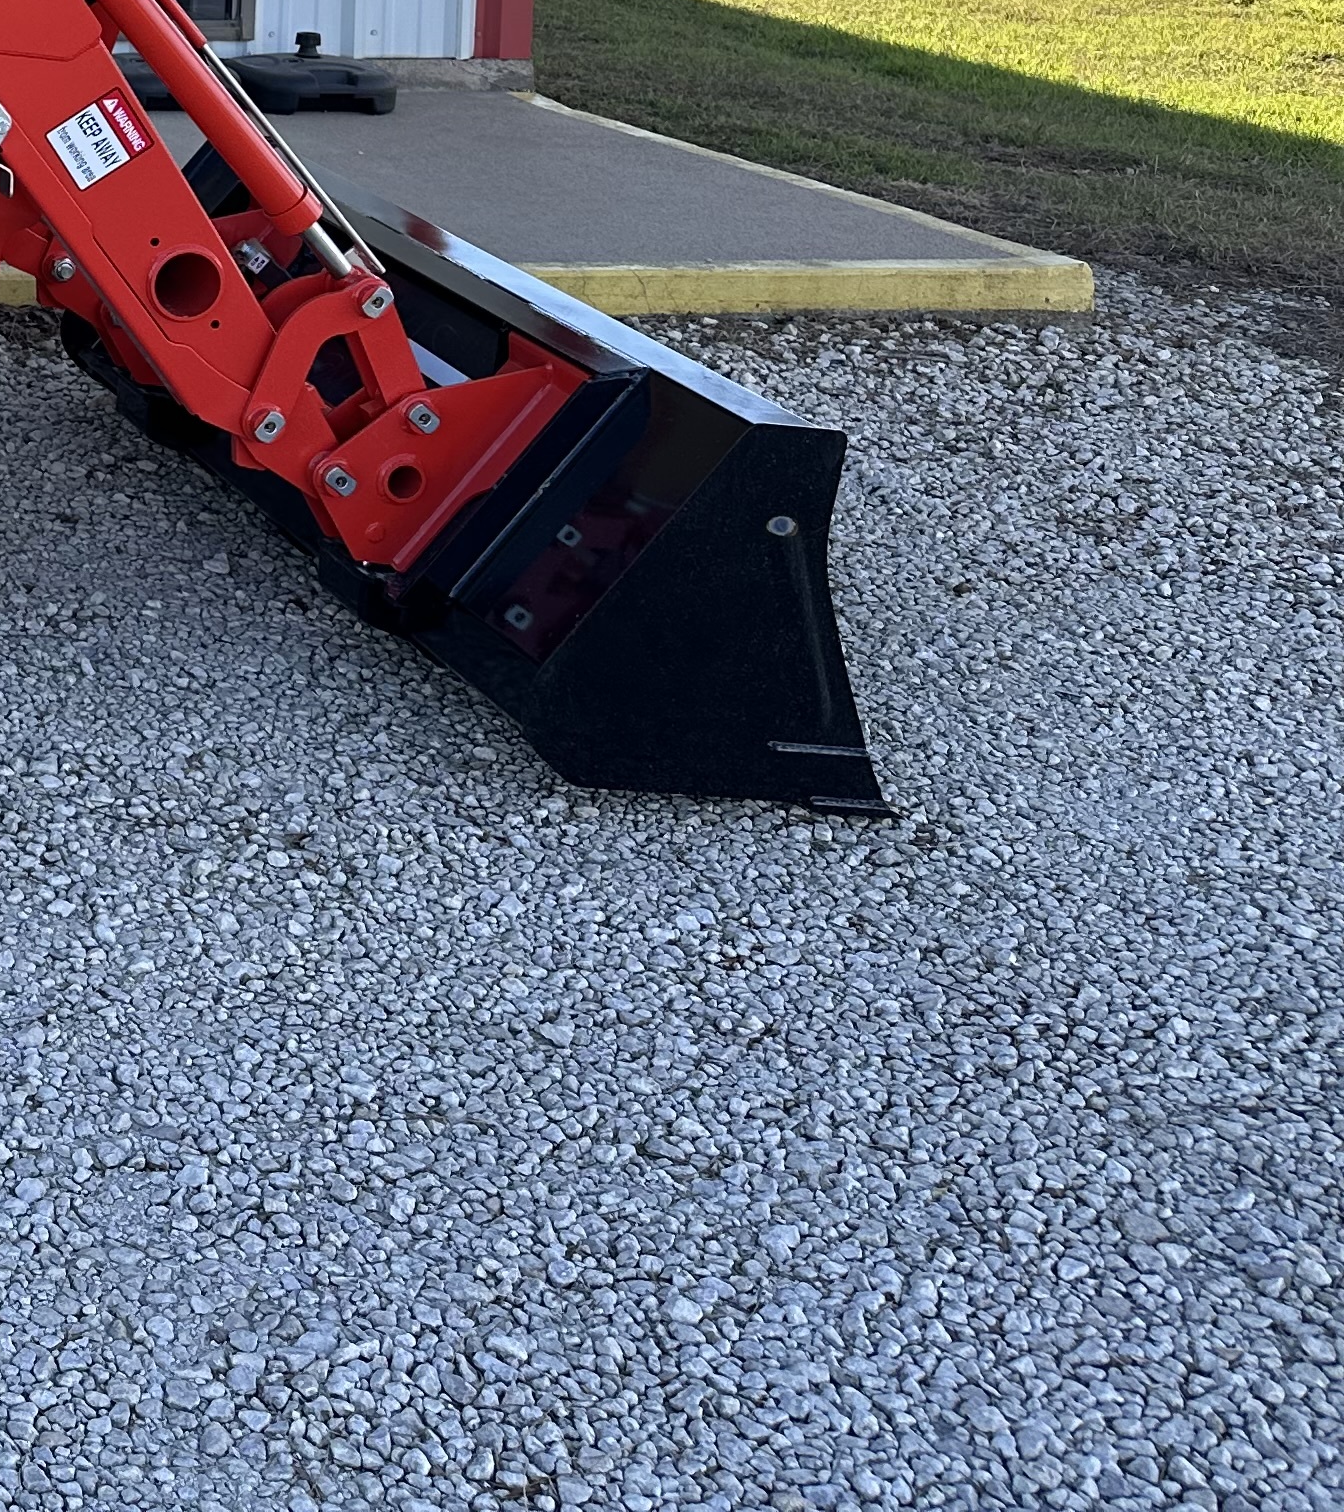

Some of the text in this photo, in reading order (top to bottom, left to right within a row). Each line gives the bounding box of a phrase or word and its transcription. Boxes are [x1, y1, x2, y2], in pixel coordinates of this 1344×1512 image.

[57, 125, 97, 182] from working area
[75, 111, 122, 169] KEEP AWAY
[113, 107, 146, 152] WARNING
